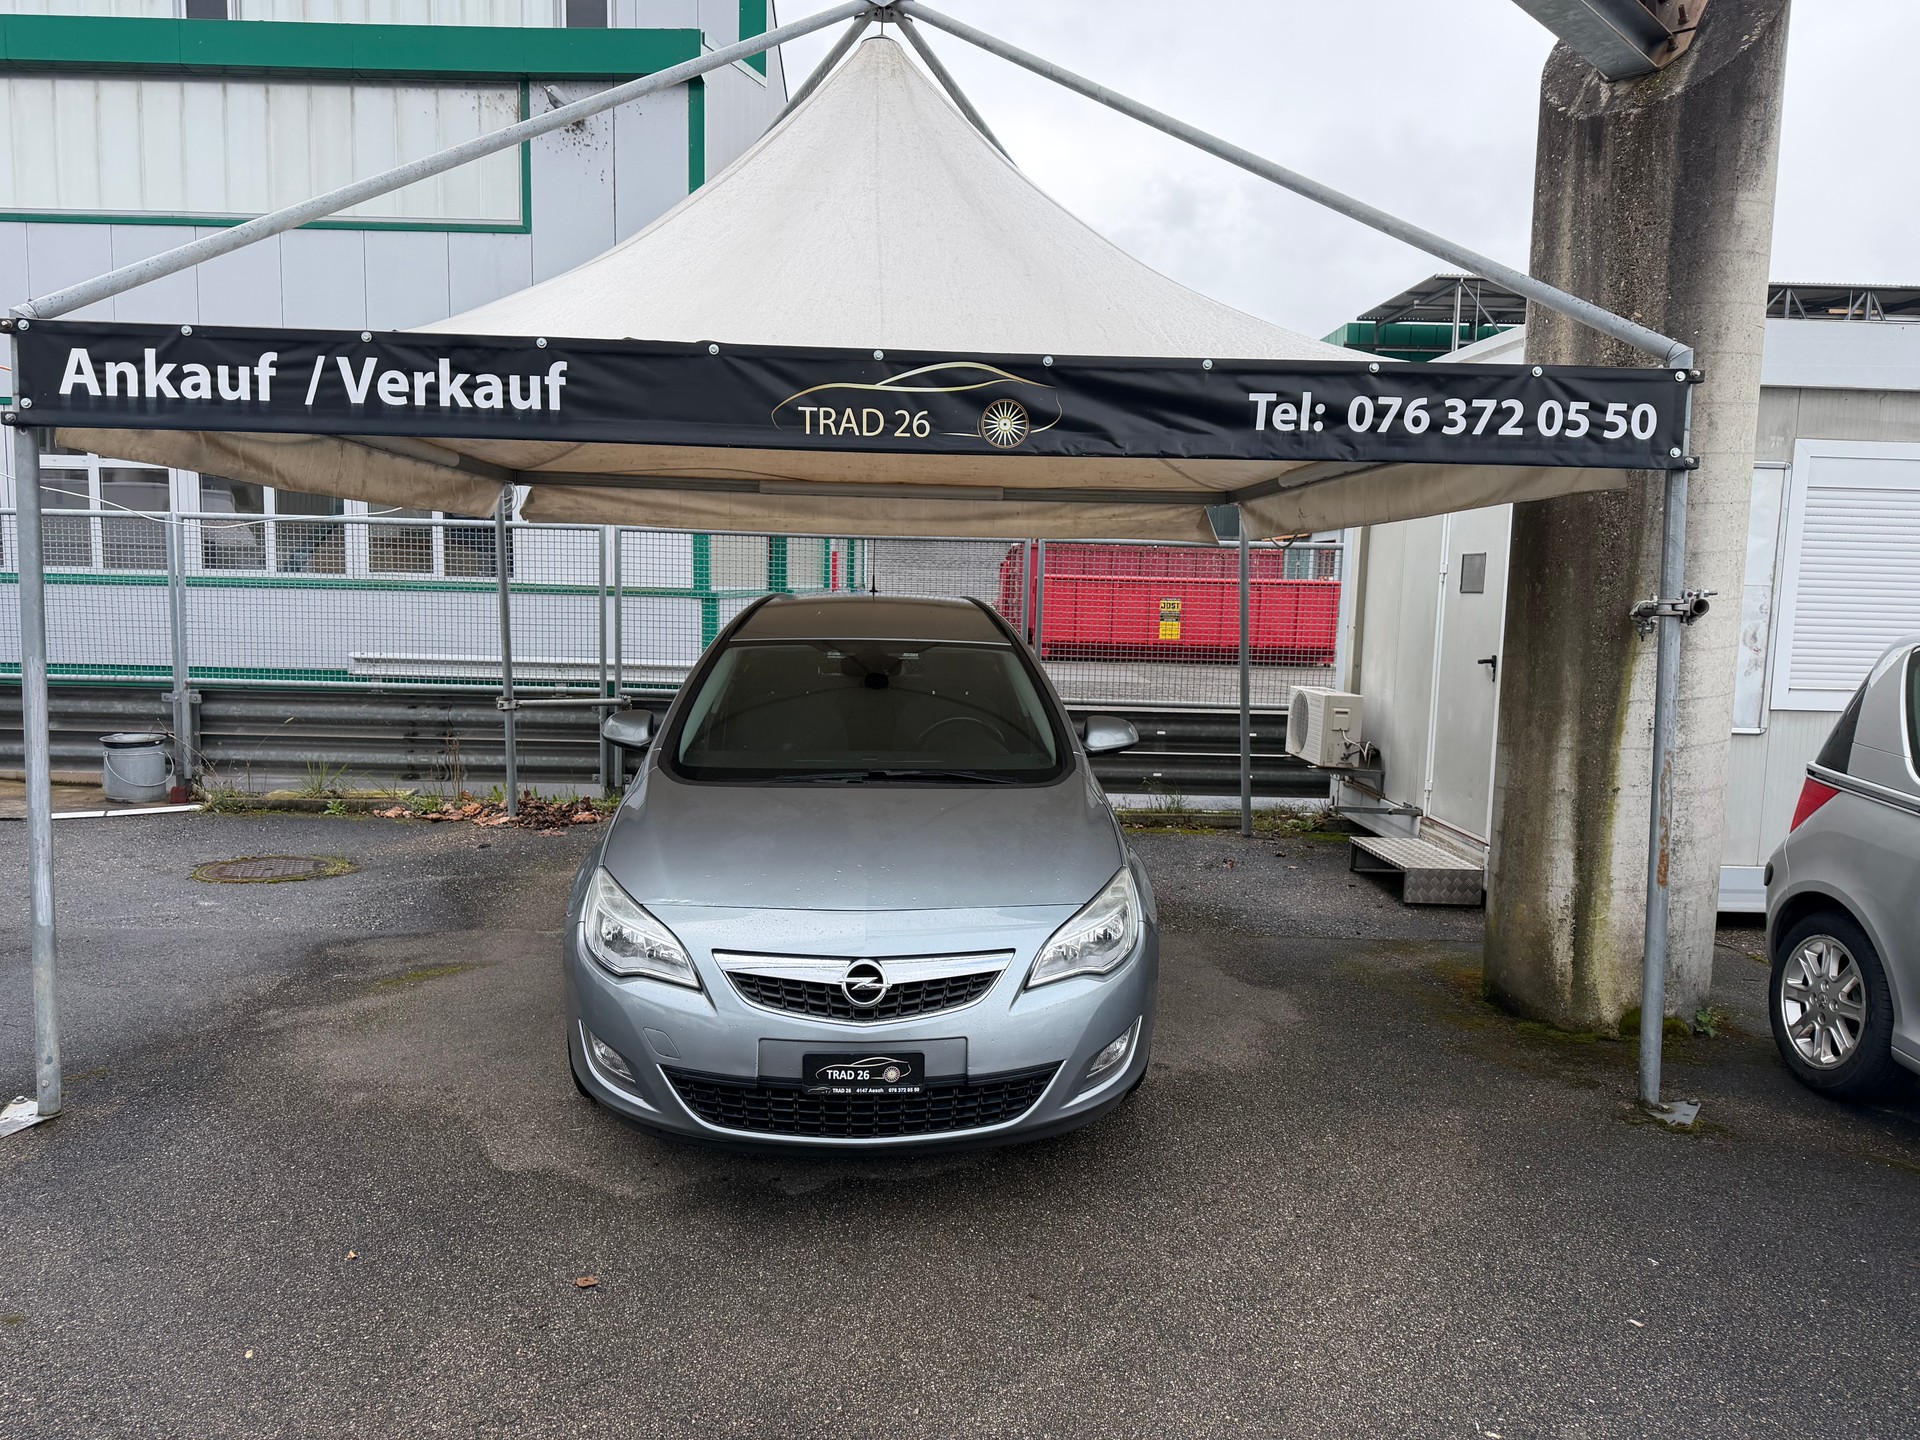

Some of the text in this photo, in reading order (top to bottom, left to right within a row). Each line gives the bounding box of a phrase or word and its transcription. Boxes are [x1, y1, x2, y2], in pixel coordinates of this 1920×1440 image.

[59, 348, 278, 402] Ankauf
[336, 356, 568, 411] Verkauf
[797, 406, 931, 438] TRAD 26
[1248, 391, 1658, 441] Tel: 076 372 05 50
[827, 1070, 870, 1080] TRAD 26
